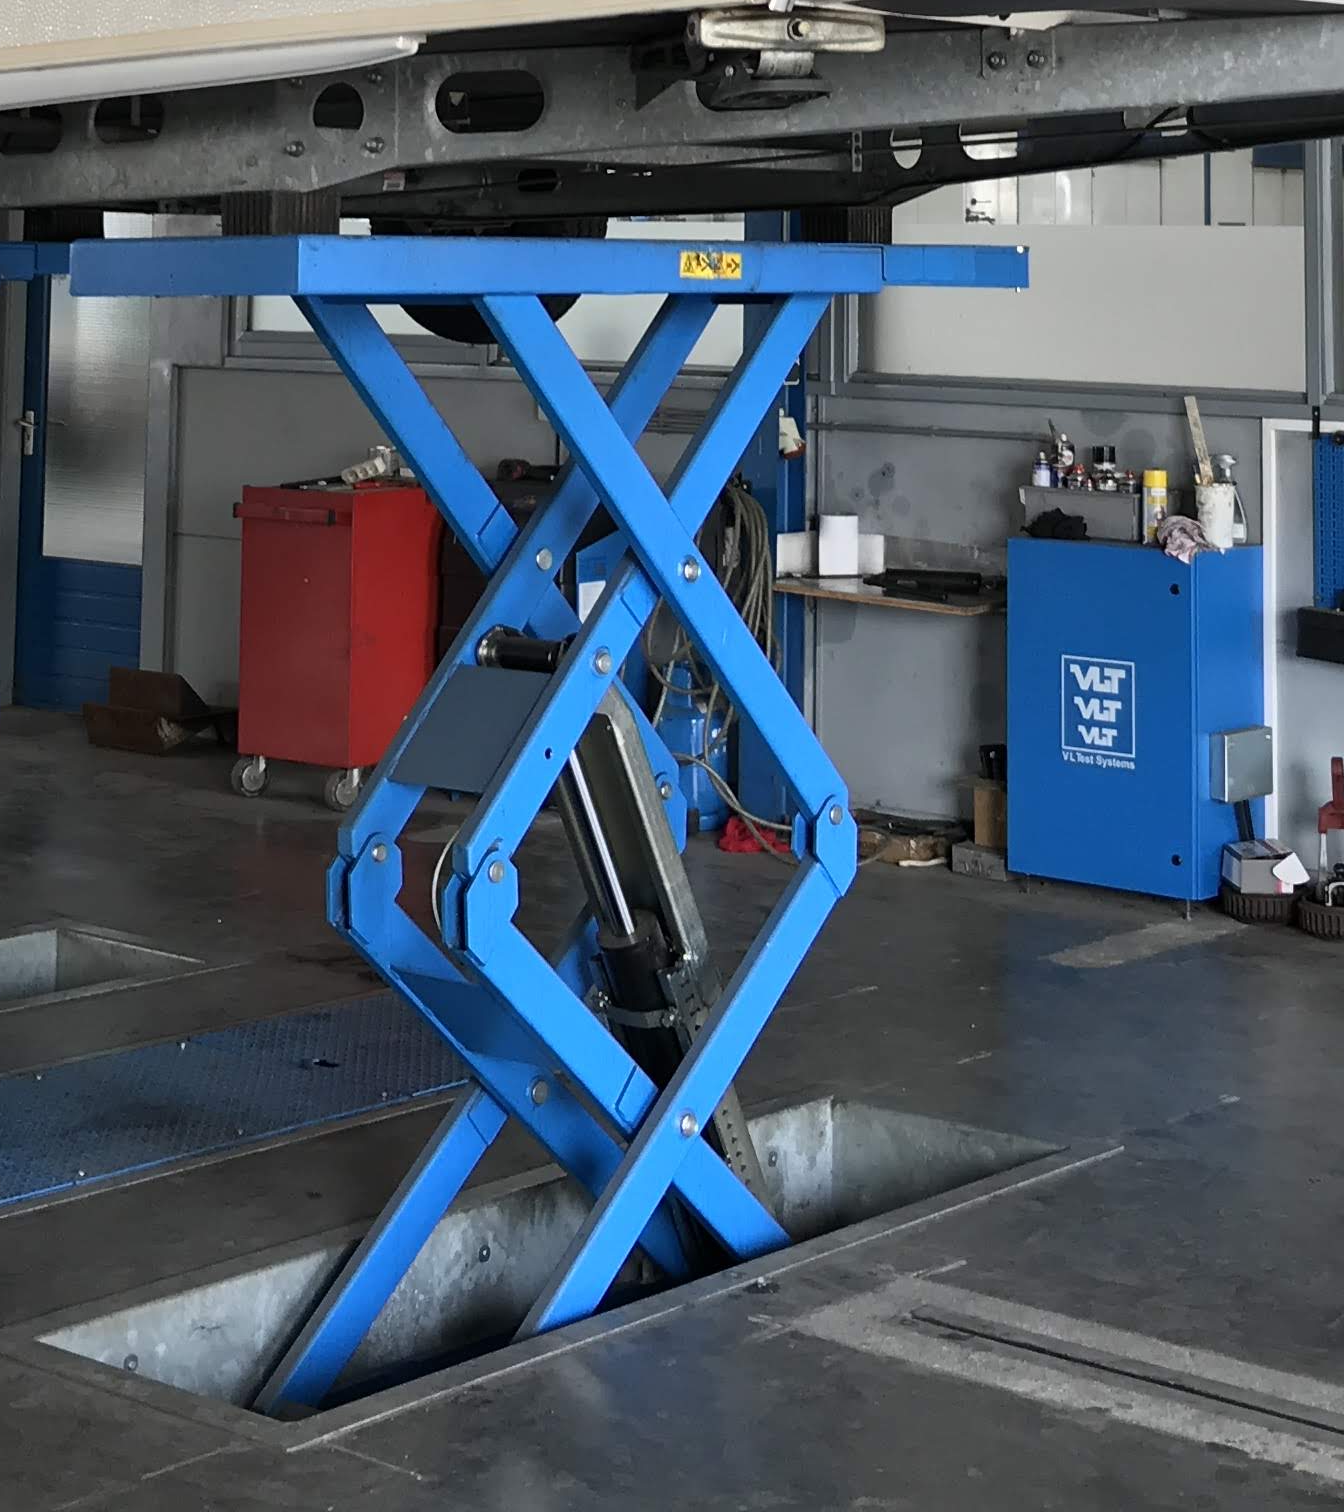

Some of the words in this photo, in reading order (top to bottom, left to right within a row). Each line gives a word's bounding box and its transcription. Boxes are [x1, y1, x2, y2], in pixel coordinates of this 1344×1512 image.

[1069, 663, 1126, 694] VLT
[1073, 695, 1122, 723] VLT
[1077, 724, 1118, 747] VLT
[1076, 752, 1094, 765] Test
[1095, 755, 1136, 770] Systems
